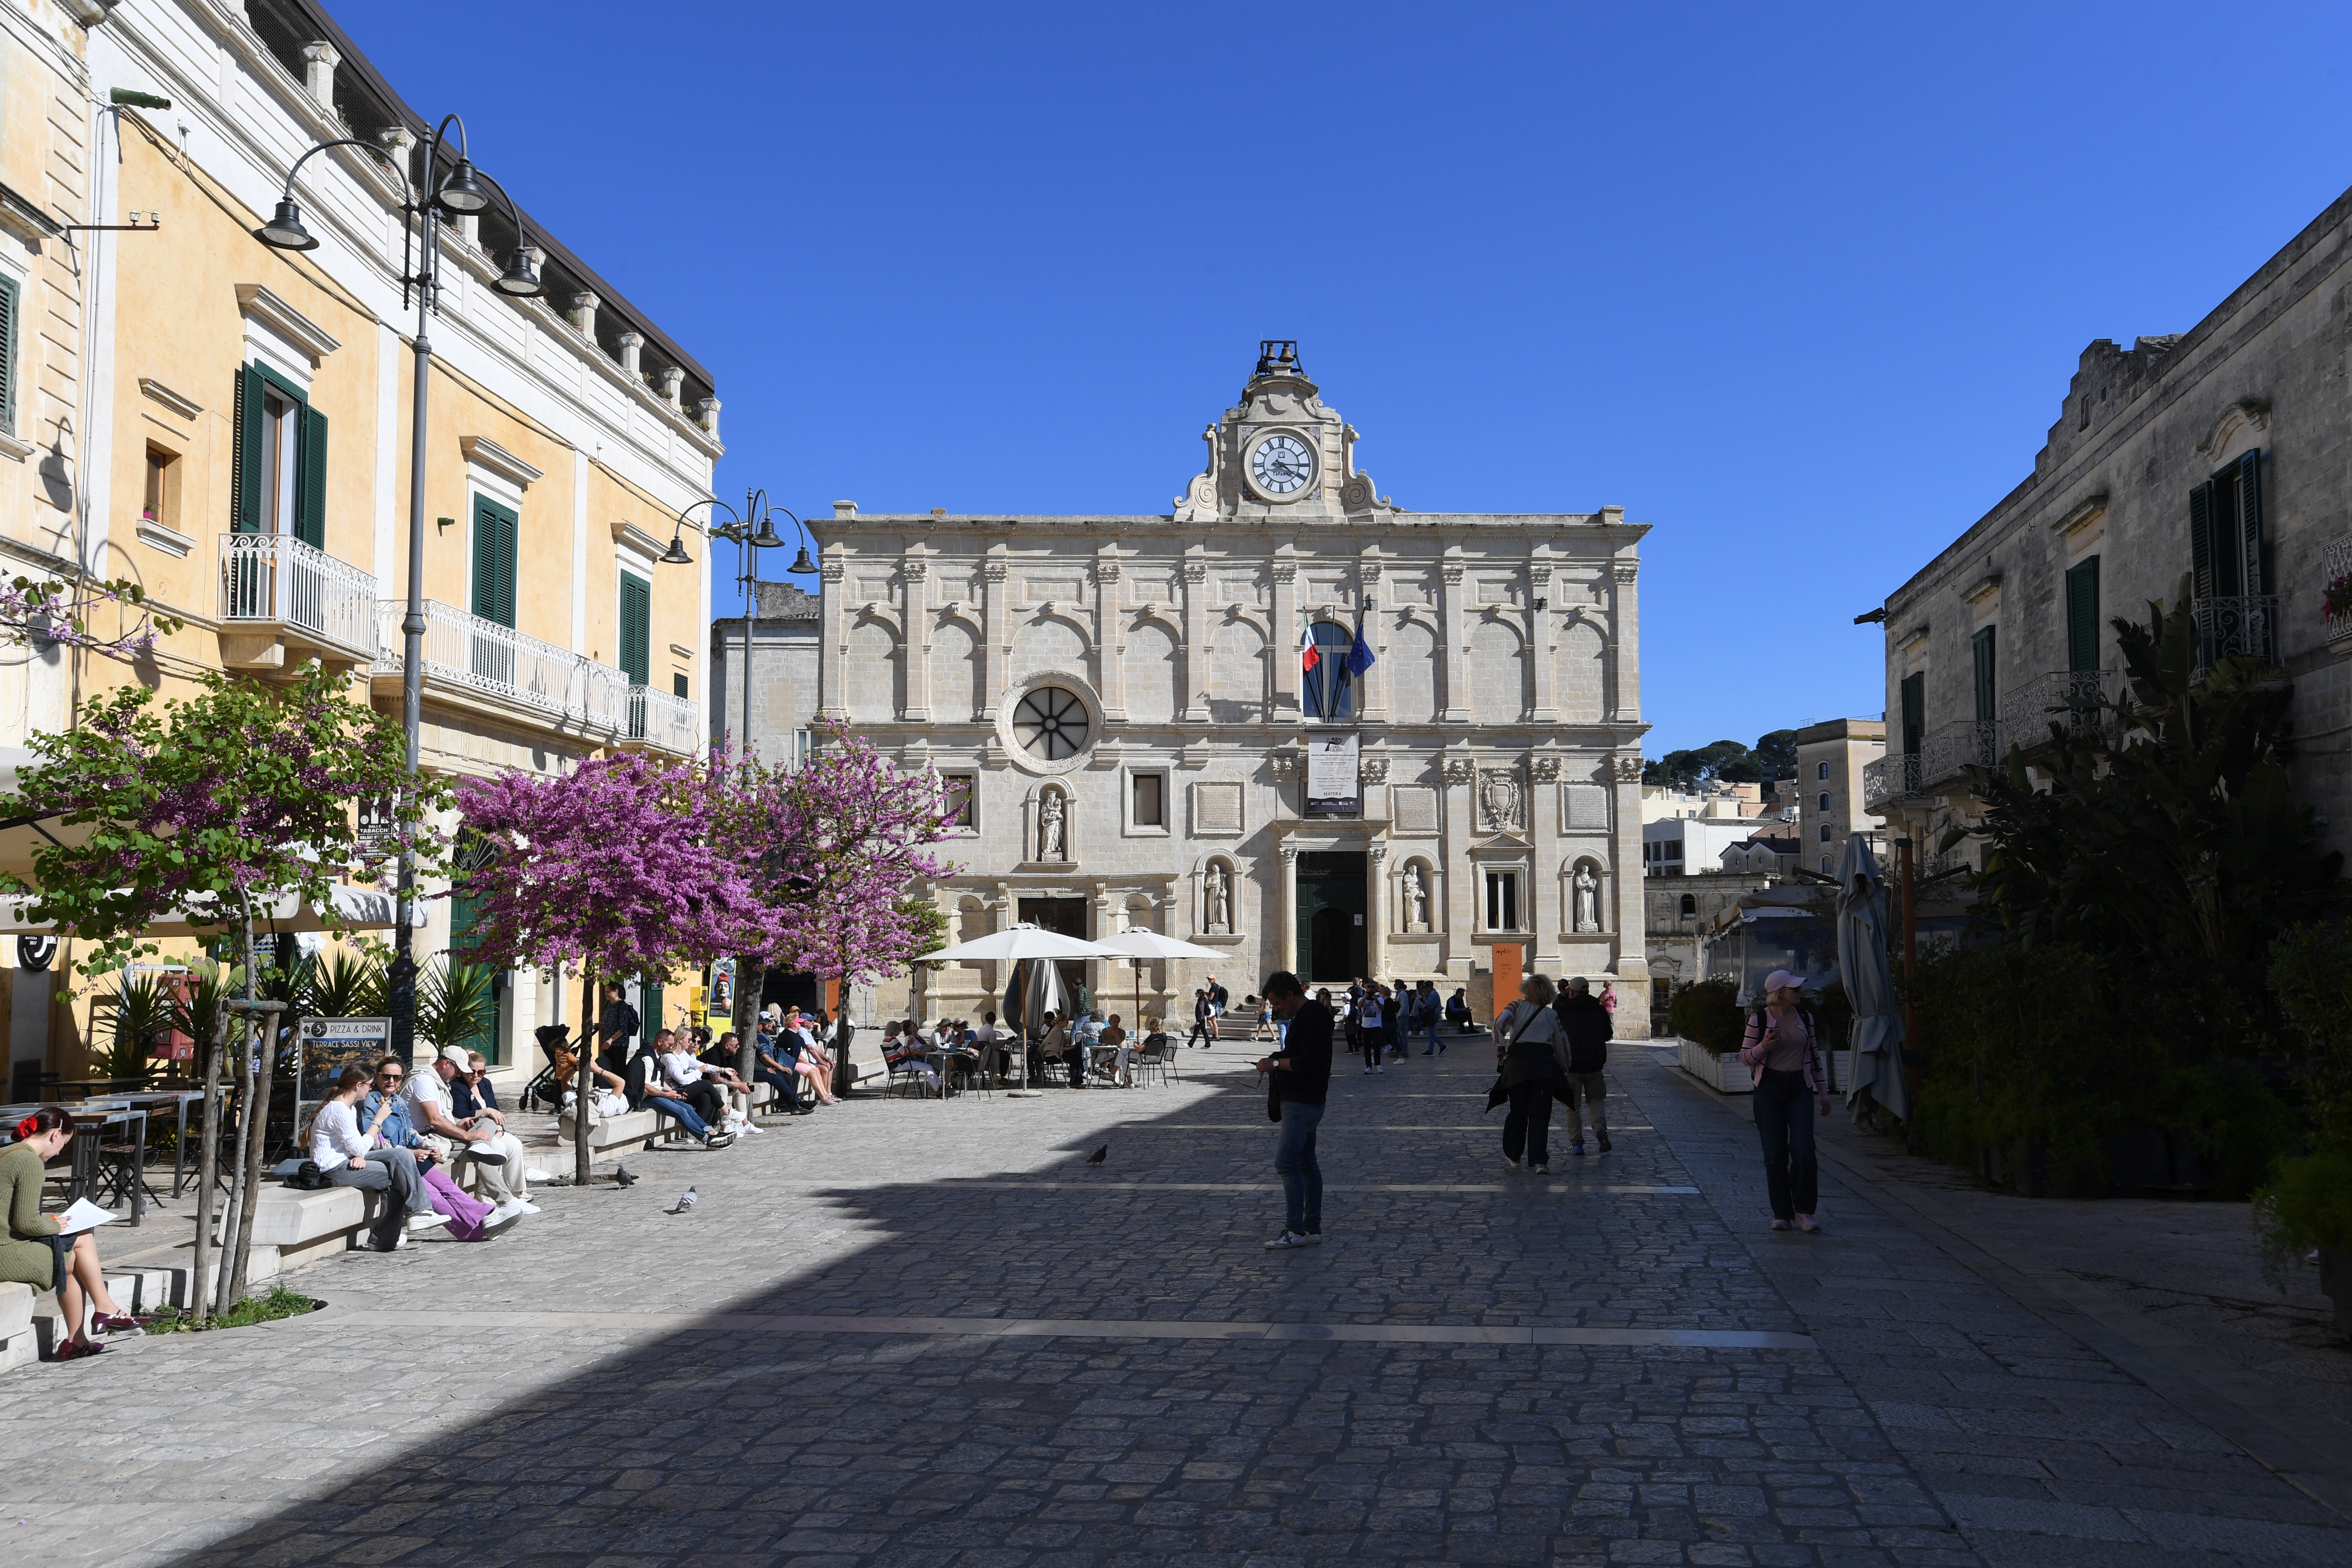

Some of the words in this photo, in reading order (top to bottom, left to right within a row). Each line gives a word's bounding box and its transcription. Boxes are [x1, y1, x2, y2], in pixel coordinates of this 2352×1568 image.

[330, 1025, 351, 1033] PIZZA
[354, 1025, 359, 1033] &
[362, 1025, 383, 1033] DRINK
